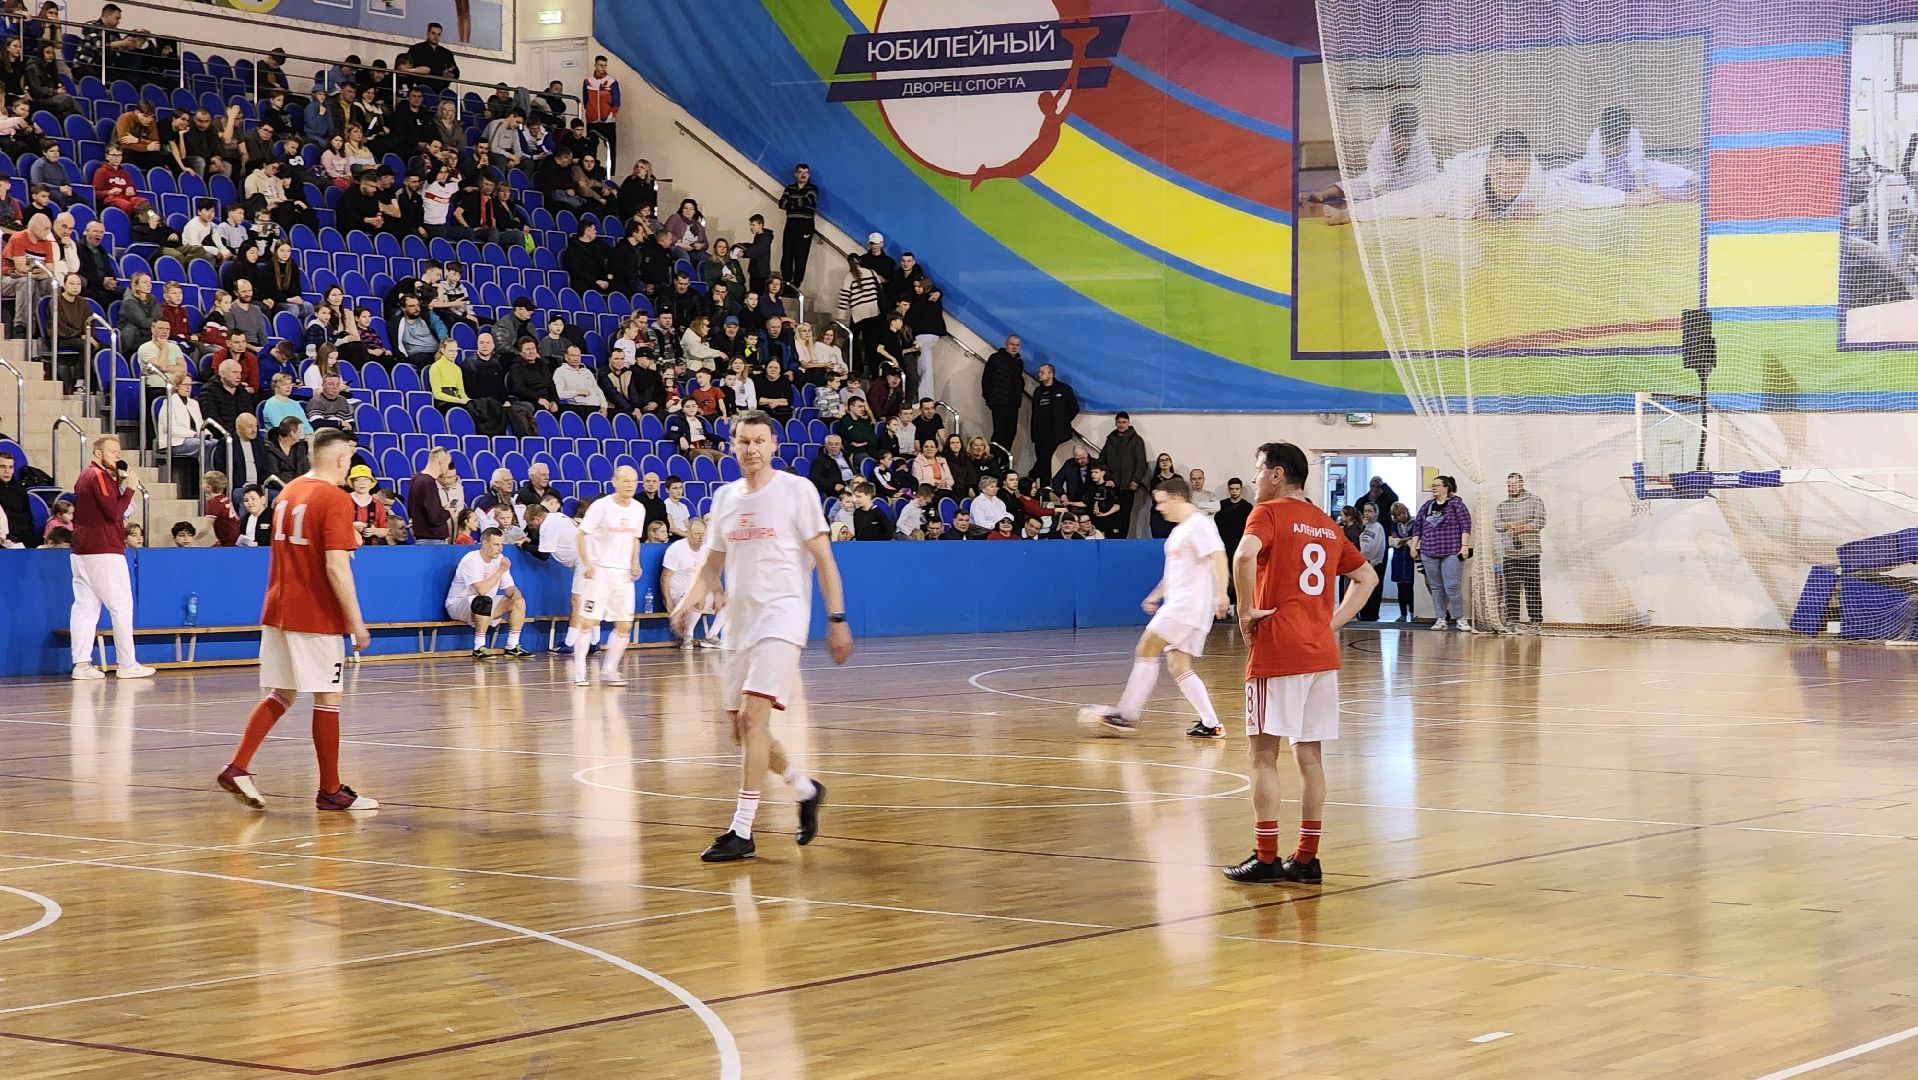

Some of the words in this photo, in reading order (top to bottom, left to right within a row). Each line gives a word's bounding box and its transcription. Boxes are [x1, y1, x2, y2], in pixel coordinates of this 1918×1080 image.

[867, 24, 1055, 62] ЮБИЛЕЙНЫЙ
[902, 81, 963, 96] ДВОРЕЦ
[965, 77, 1026, 91] СПОРТА
[274, 500, 310, 545] 11
[1299, 543, 1326, 596] 8
[332, 662, 342, 684] 3
[1247, 685, 1254, 714] 8
